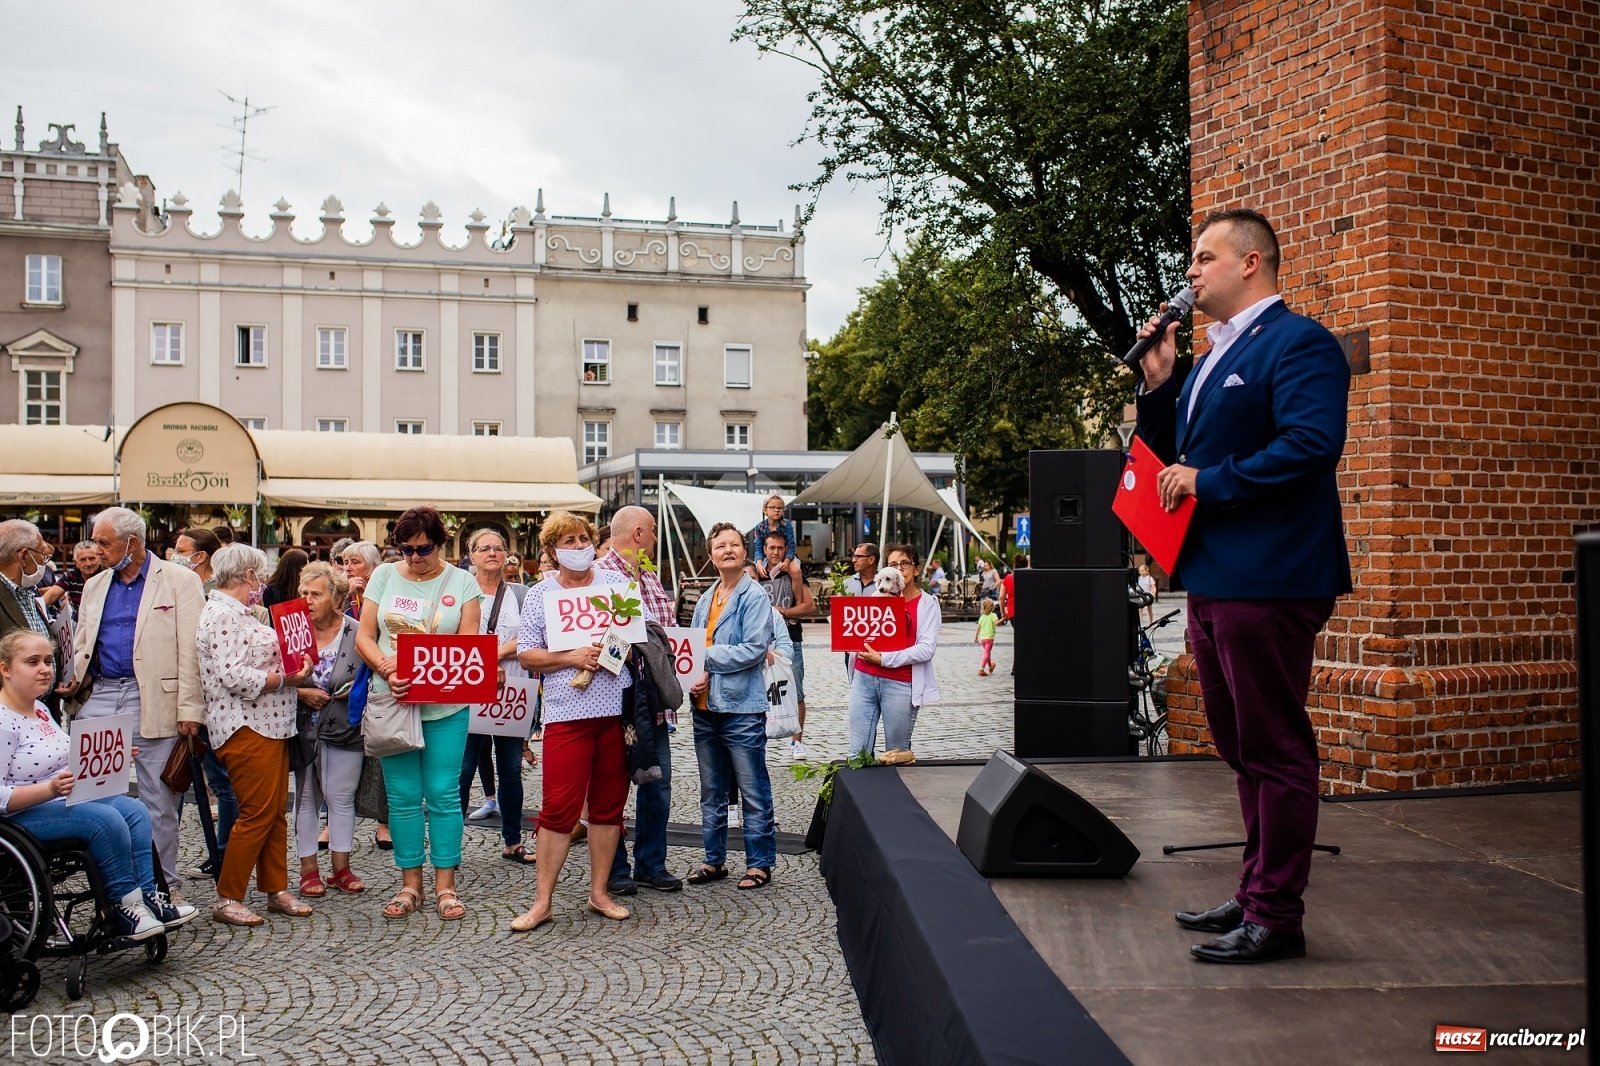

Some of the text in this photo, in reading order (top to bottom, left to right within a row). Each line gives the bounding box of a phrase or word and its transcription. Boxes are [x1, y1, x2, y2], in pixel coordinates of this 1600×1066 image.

[394, 602, 418, 612] 2020
[395, 597, 418, 607] DUDA
[558, 593, 625, 616] DUD
[280, 610, 309, 635] DUDA
[843, 606, 896, 622] DUDA
[842, 621, 897, 637] 2020
[285, 628, 312, 655] 2020
[413, 646, 484, 666] DUDA
[411, 665, 485, 685] 2020
[477, 702, 527, 721] 2020
[80, 728, 125, 757] DUDA
[77, 750, 125, 780] 2020
